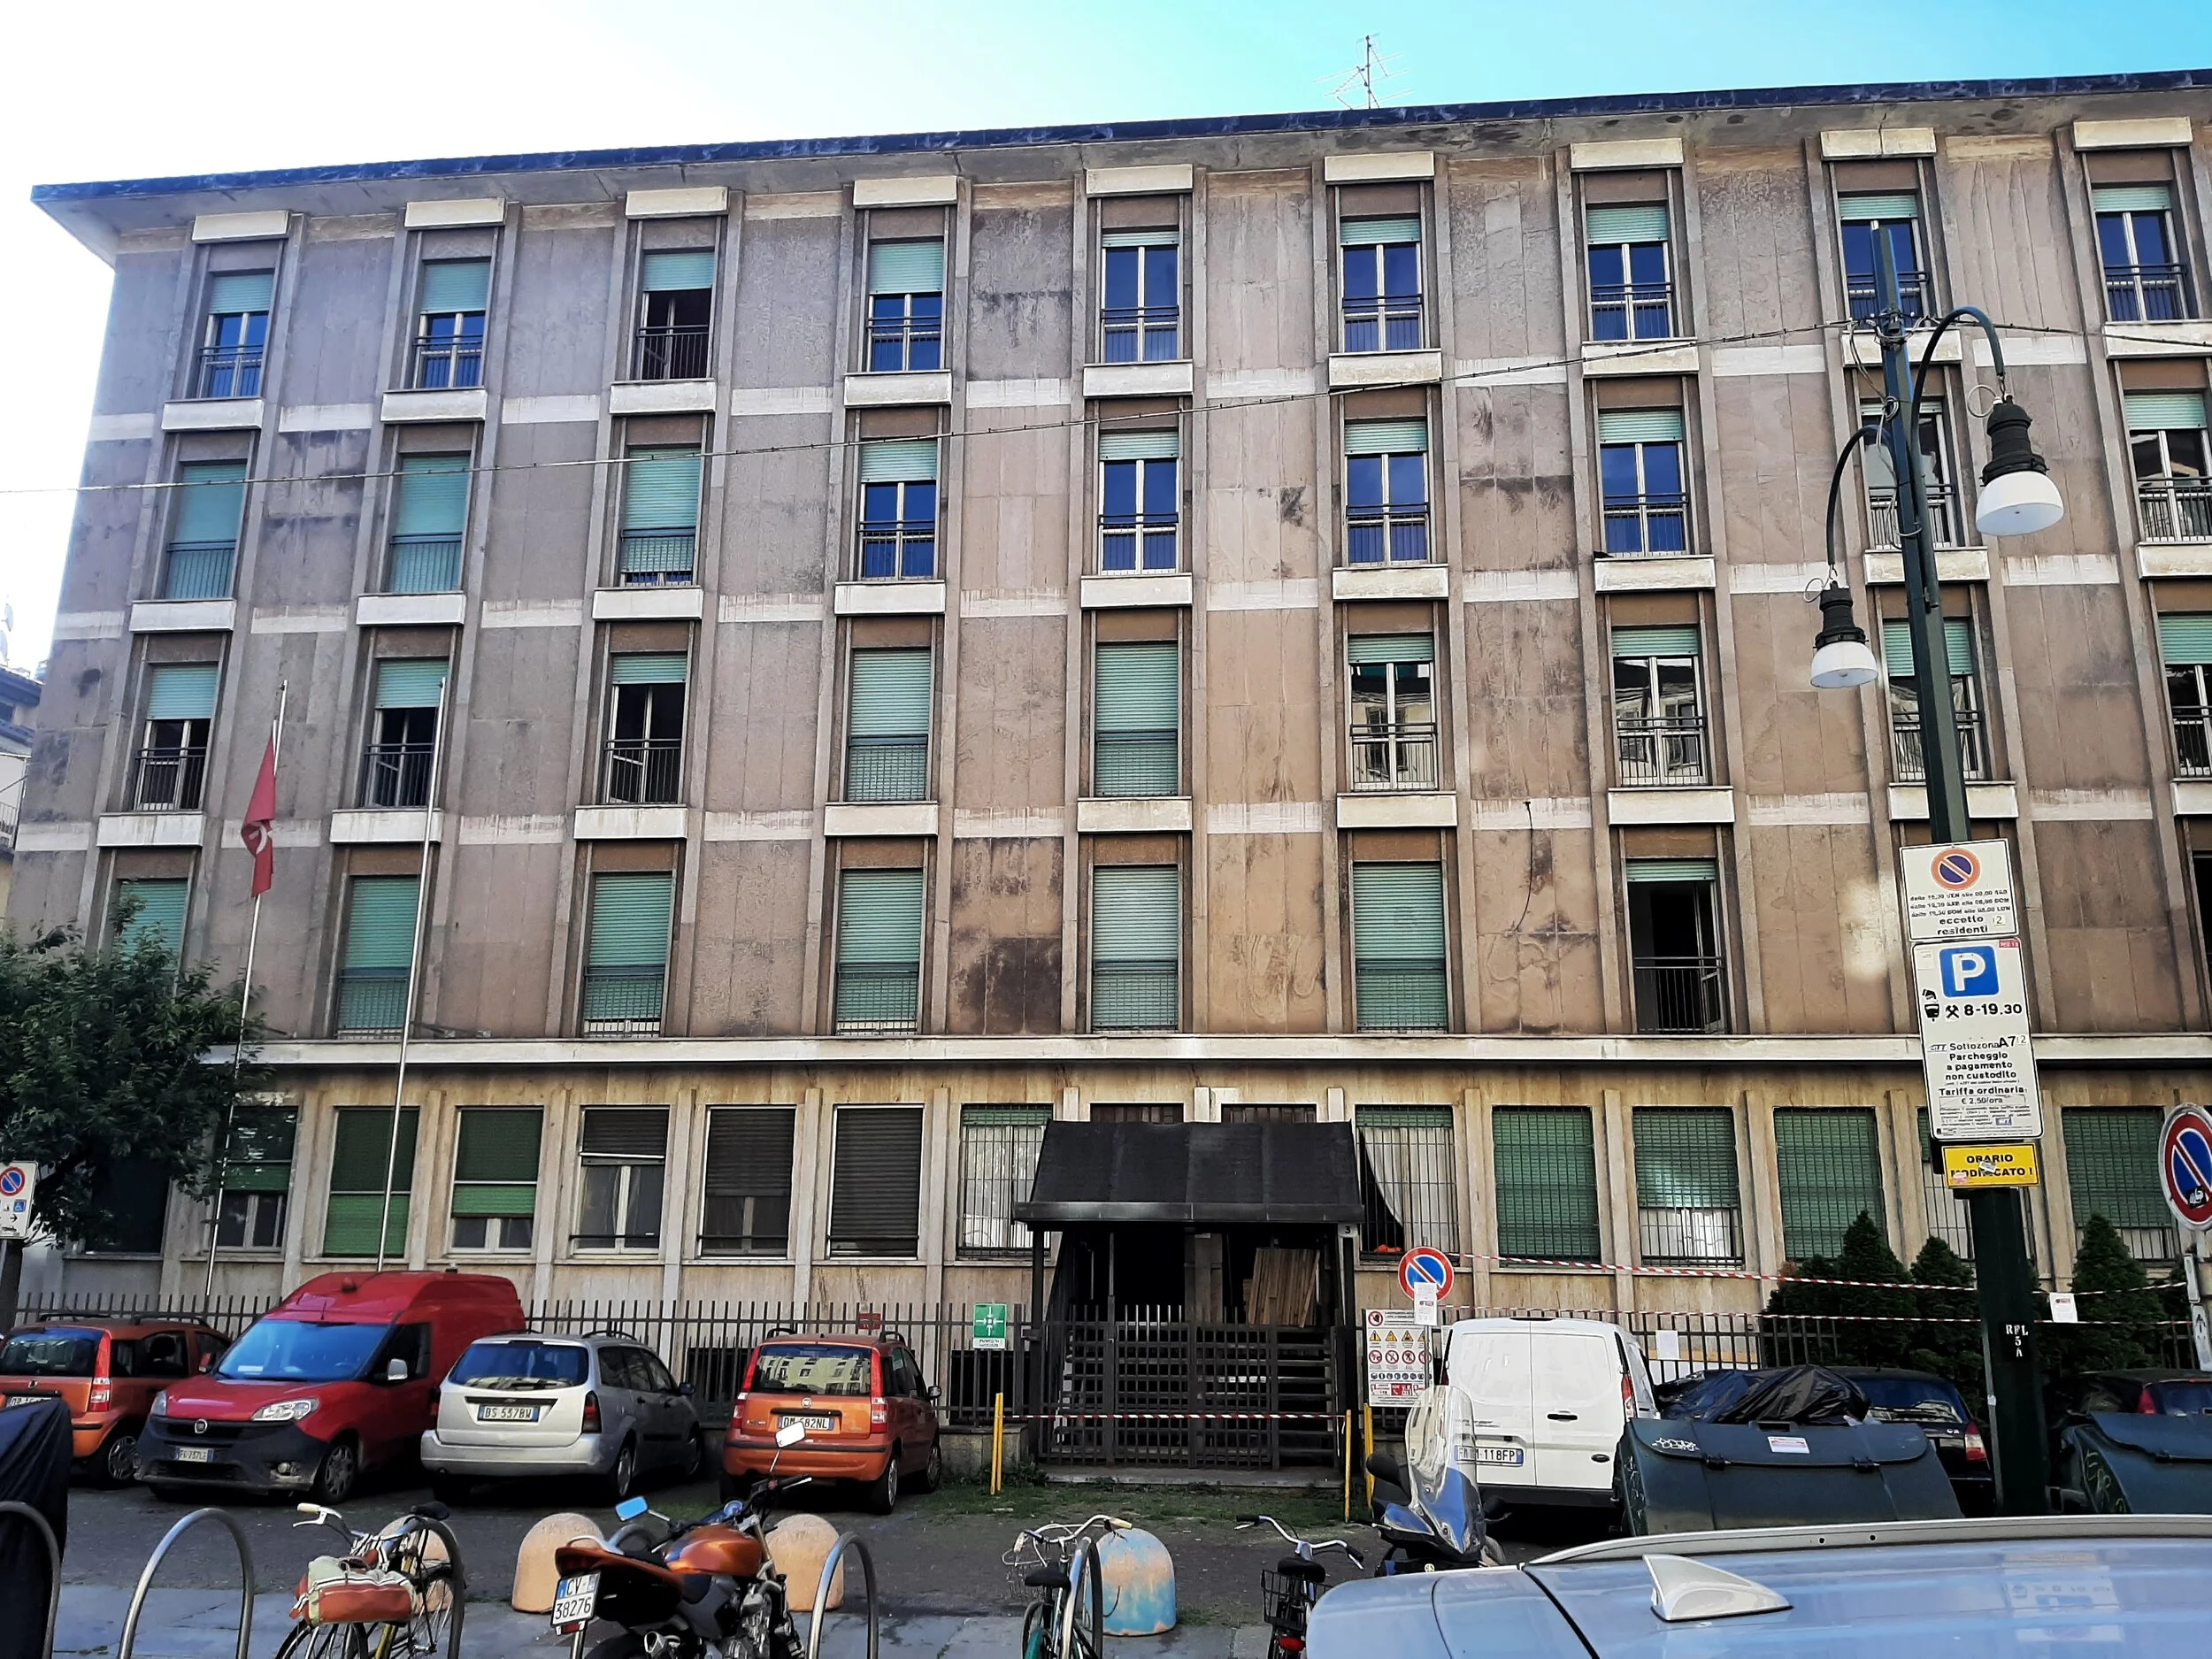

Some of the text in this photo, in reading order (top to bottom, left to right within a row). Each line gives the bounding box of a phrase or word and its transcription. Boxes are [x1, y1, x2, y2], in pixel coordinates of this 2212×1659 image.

[1939, 915, 1984, 925] eccetto
[1937, 925, 1988, 935] residenti
[1952, 952, 1985, 991] P
[1964, 1003, 2023, 1016] 8-19.30
[1949, 1051, 2008, 1061] Parcheggio
[1955, 1061, 2013, 1071] pagamento
[1966, 1071, 2016, 1079] custodito
[1939, 1087, 1974, 1096] Tariffa
[1966, 1155, 2013, 1164] ORARIO
[1345, 1225, 1351, 1234] 3
[2015, 1336, 2022, 1346] 5
[800, 1417, 827, 1429] 82NL
[567, 1578, 582, 1595] CV
[555, 1597, 591, 1620] 38276
